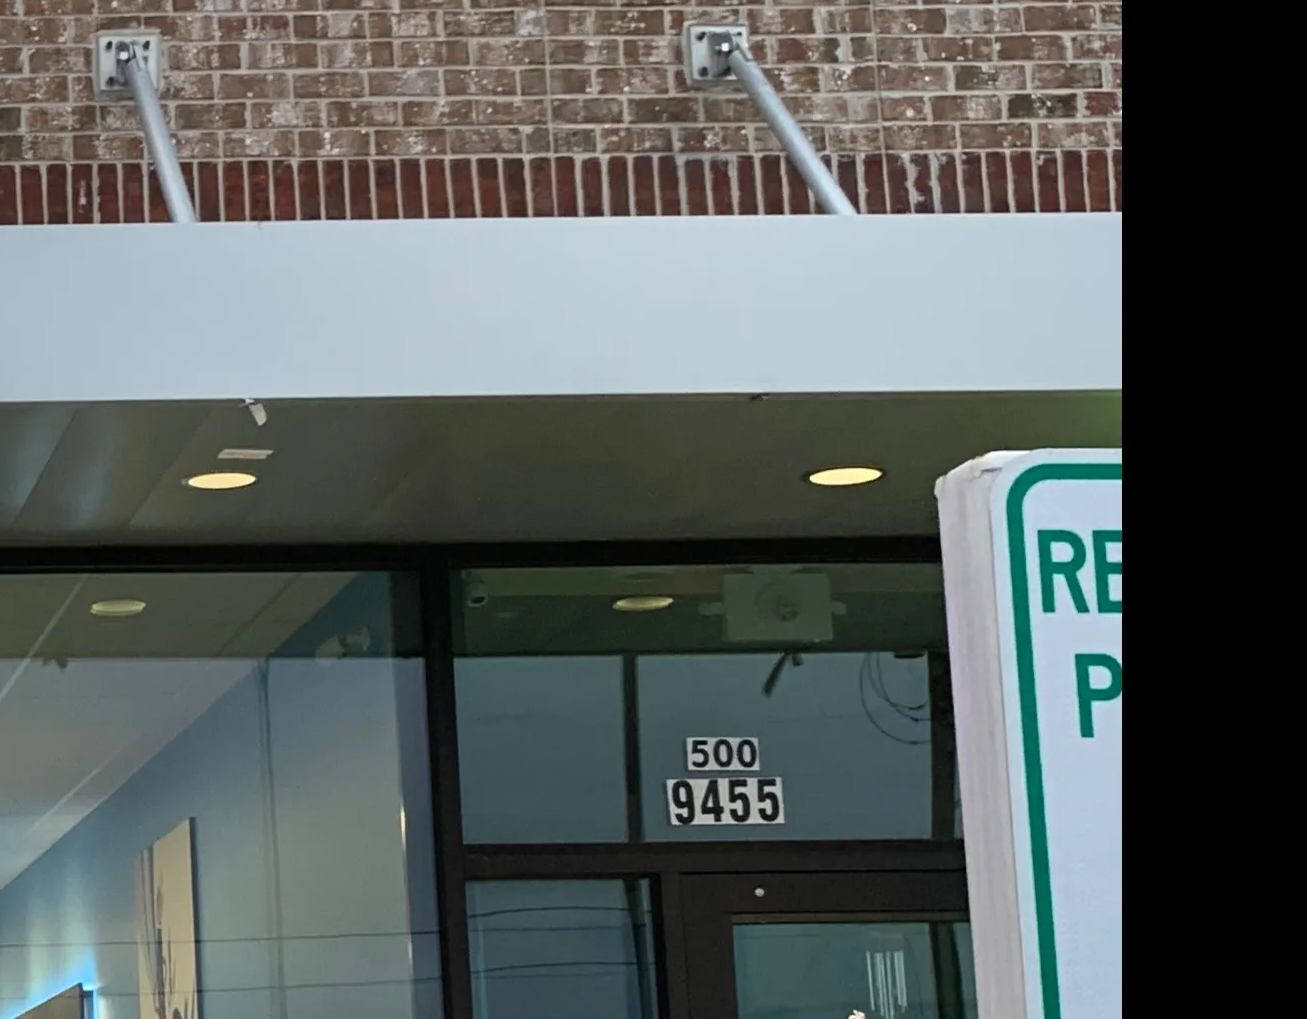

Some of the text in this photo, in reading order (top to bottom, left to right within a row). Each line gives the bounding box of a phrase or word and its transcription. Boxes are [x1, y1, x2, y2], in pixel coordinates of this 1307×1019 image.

[1074, 653, 1122, 738] P
[690, 739, 758, 769] 500
[671, 778, 781, 824] 9455
